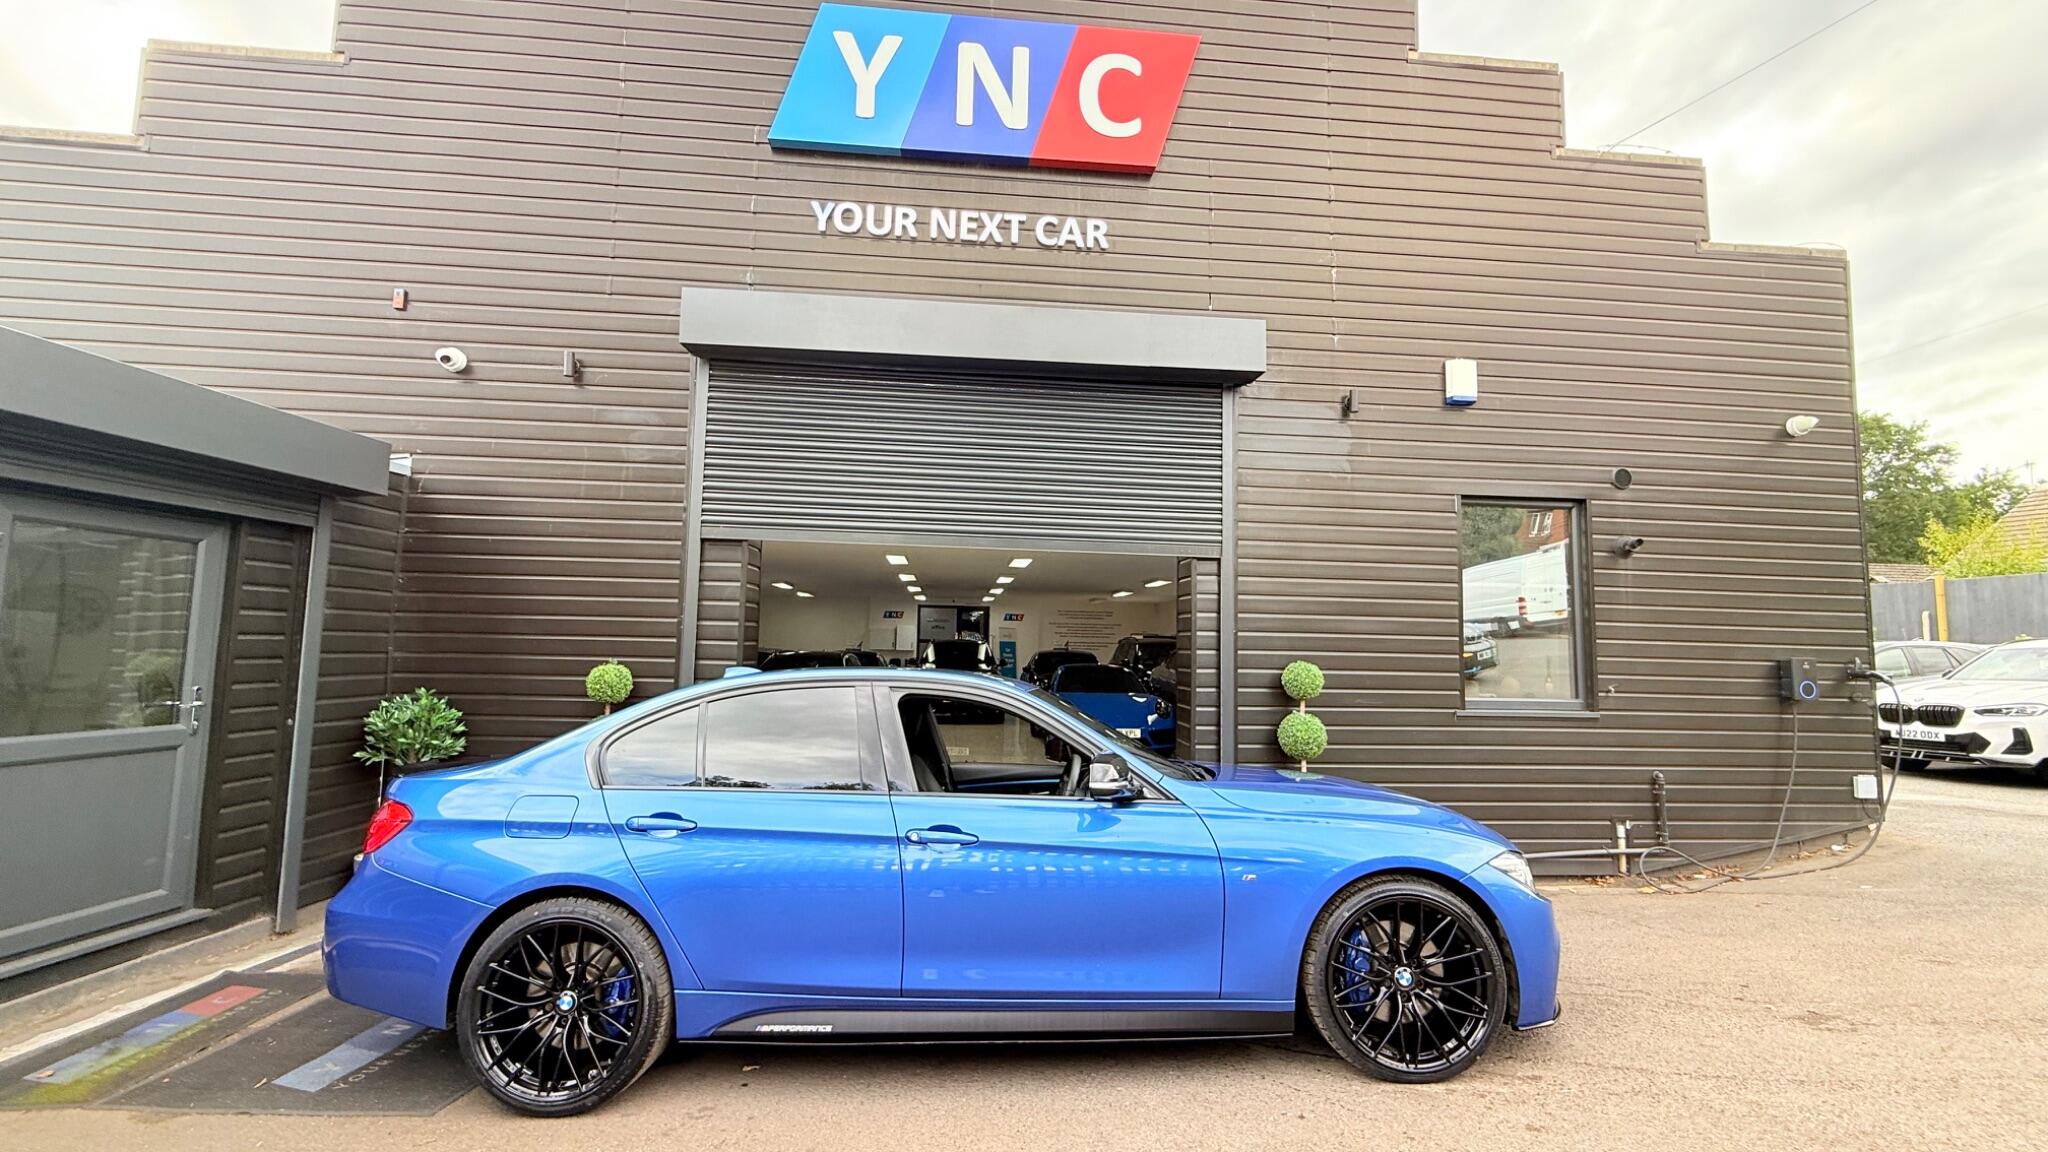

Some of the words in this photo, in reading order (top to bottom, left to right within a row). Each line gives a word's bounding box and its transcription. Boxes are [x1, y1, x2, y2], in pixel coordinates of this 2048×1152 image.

[832, 30, 1142, 138] YNC
[810, 200, 917, 238] YOUR
[930, 208, 1026, 244] NEXT
[1035, 216, 1109, 249] CAR
